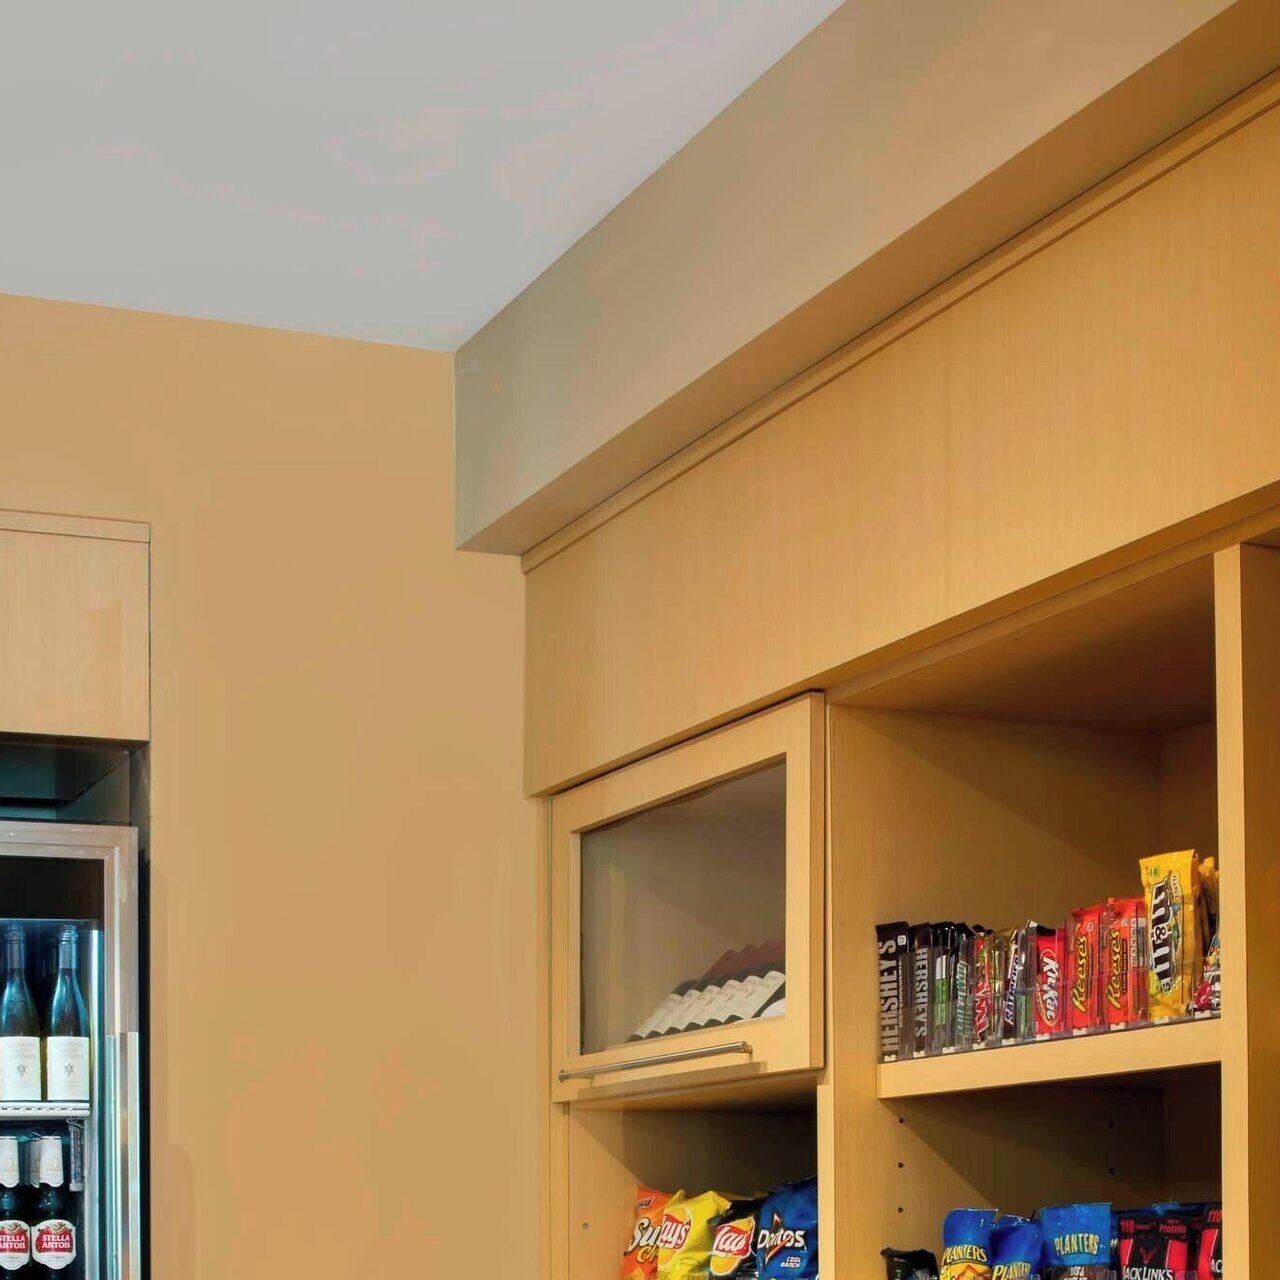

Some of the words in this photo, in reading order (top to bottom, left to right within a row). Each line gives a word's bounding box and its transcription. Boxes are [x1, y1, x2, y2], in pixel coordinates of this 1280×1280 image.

[1071, 935, 1088, 1013] Reese's
[1106, 930, 1121, 1009] Reese's
[880, 939, 898, 1054] HERSHEY'S
[915, 947, 928, 1038] HERSHEY'S
[41, 1241, 70, 1249] ARTOIS
[42, 1234, 70, 1242] STELLA
[659, 1219, 690, 1249] ay's
[757, 1227, 807, 1249] Doritos
[1054, 1233, 1100, 1256] PLANTERS
[941, 1245, 988, 1265] PLANTERS
